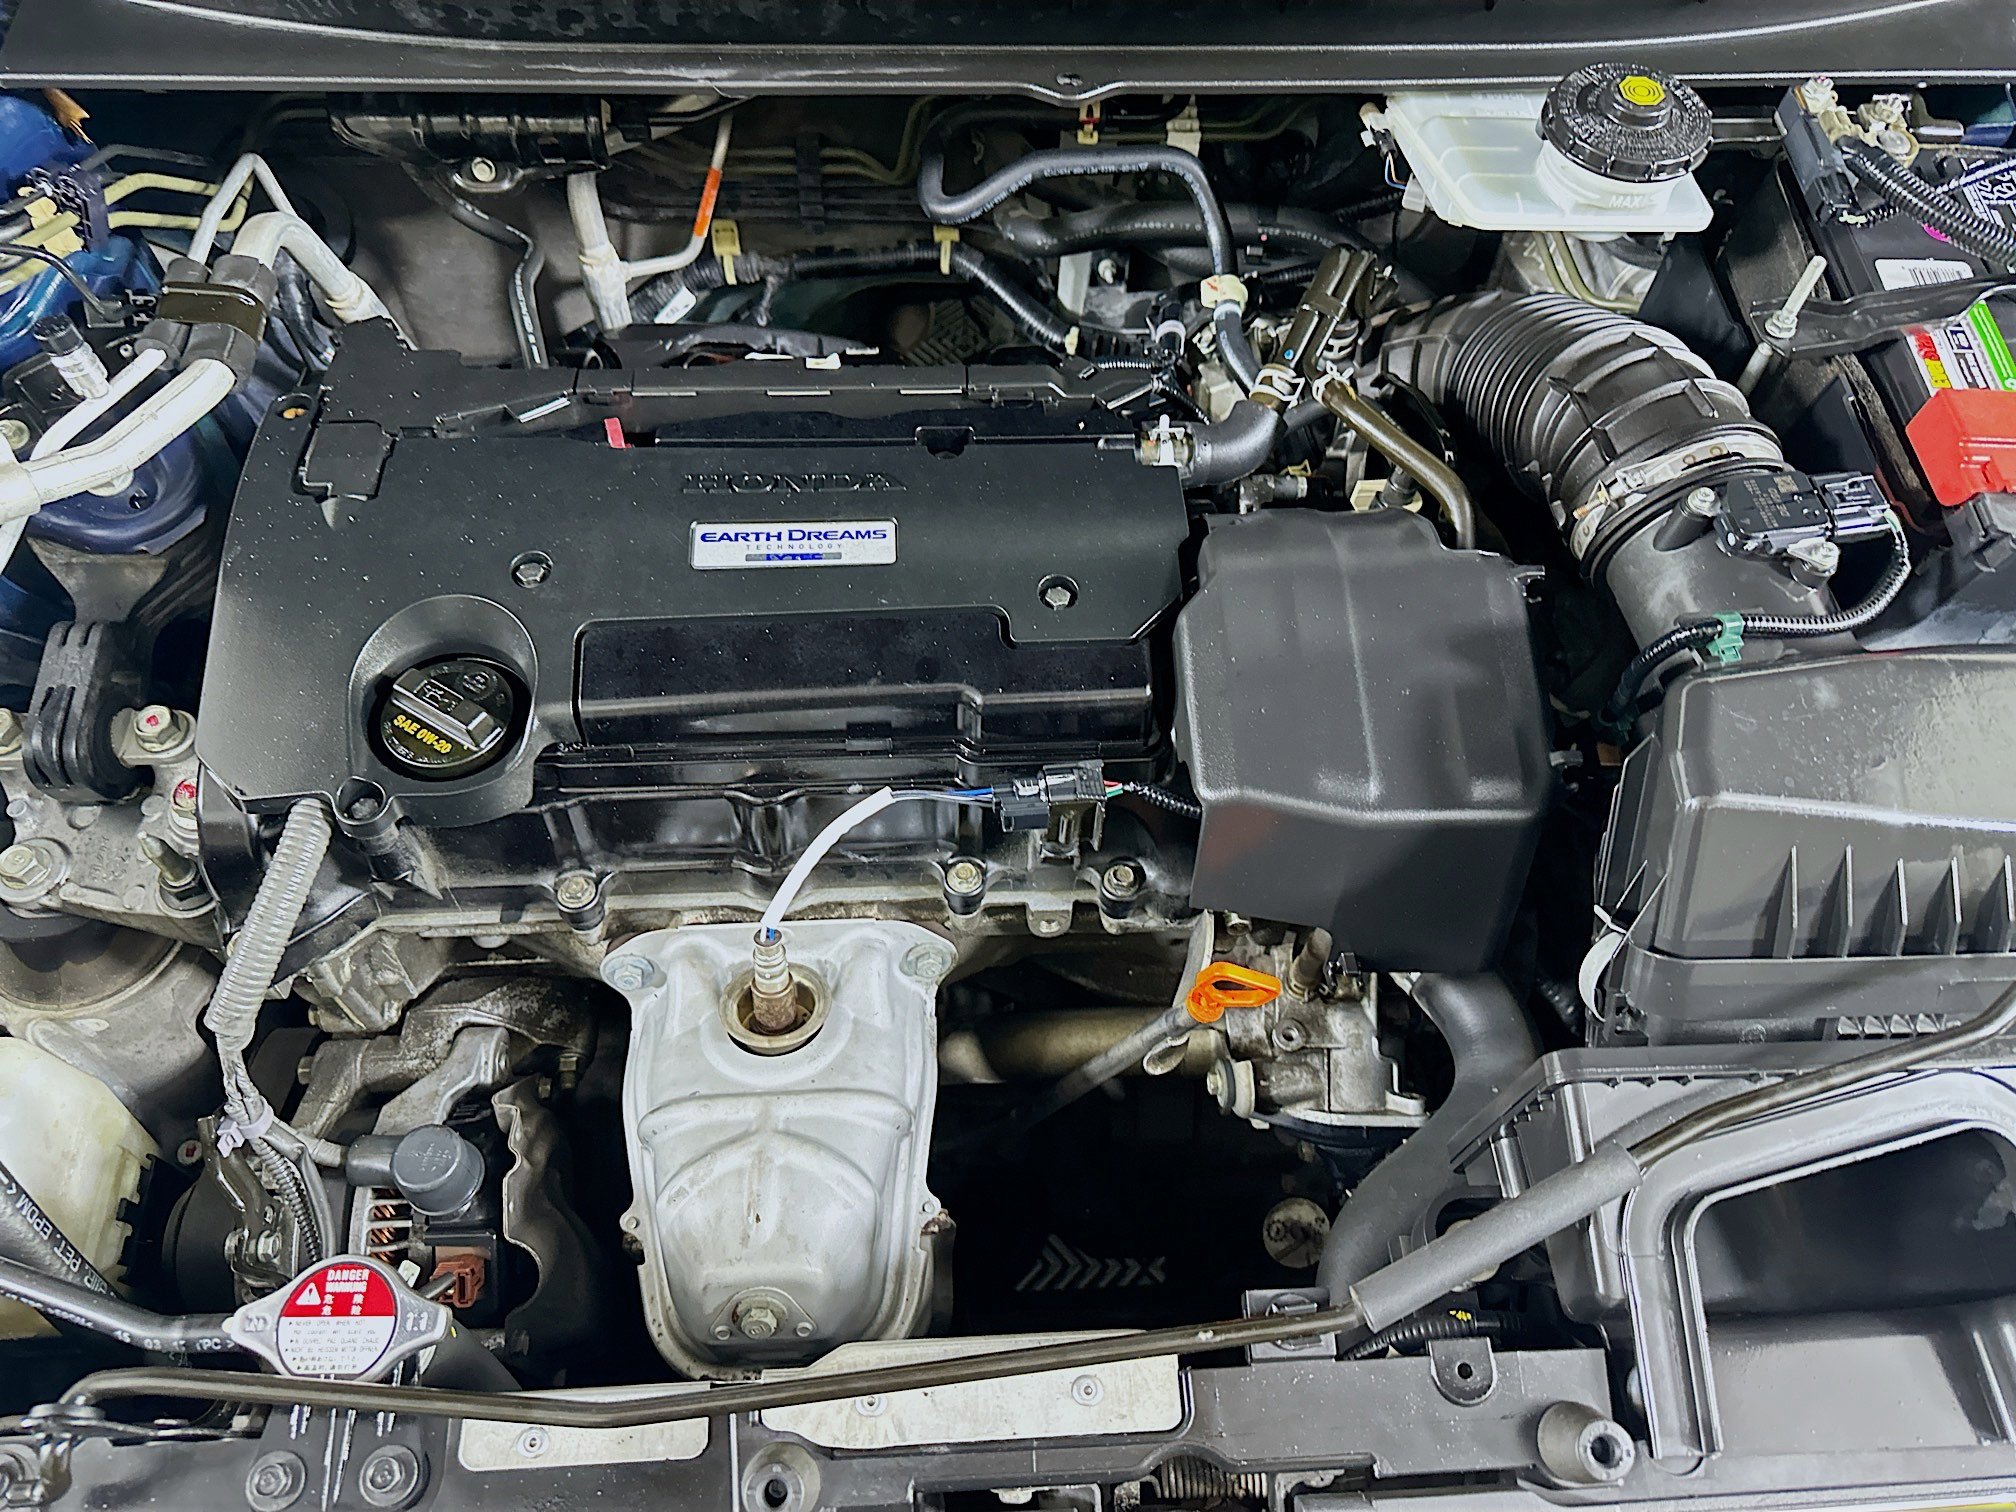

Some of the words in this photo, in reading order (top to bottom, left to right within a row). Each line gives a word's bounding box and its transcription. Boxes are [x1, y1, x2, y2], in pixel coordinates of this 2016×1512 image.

[1608, 194, 1643, 208] MAX
[683, 472, 907, 494] HONDA
[700, 531, 782, 543] EARTH
[788, 529, 888, 542] DREAMS
[746, 543, 843, 551] TECHNOLOGY
[393, 714, 420, 736] SAE
[416, 729, 453, 754] 0W-20
[15, 1193, 53, 1241] EPDM
[326, 1269, 370, 1281] DANGER
[325, 1281, 367, 1293] WARNING
